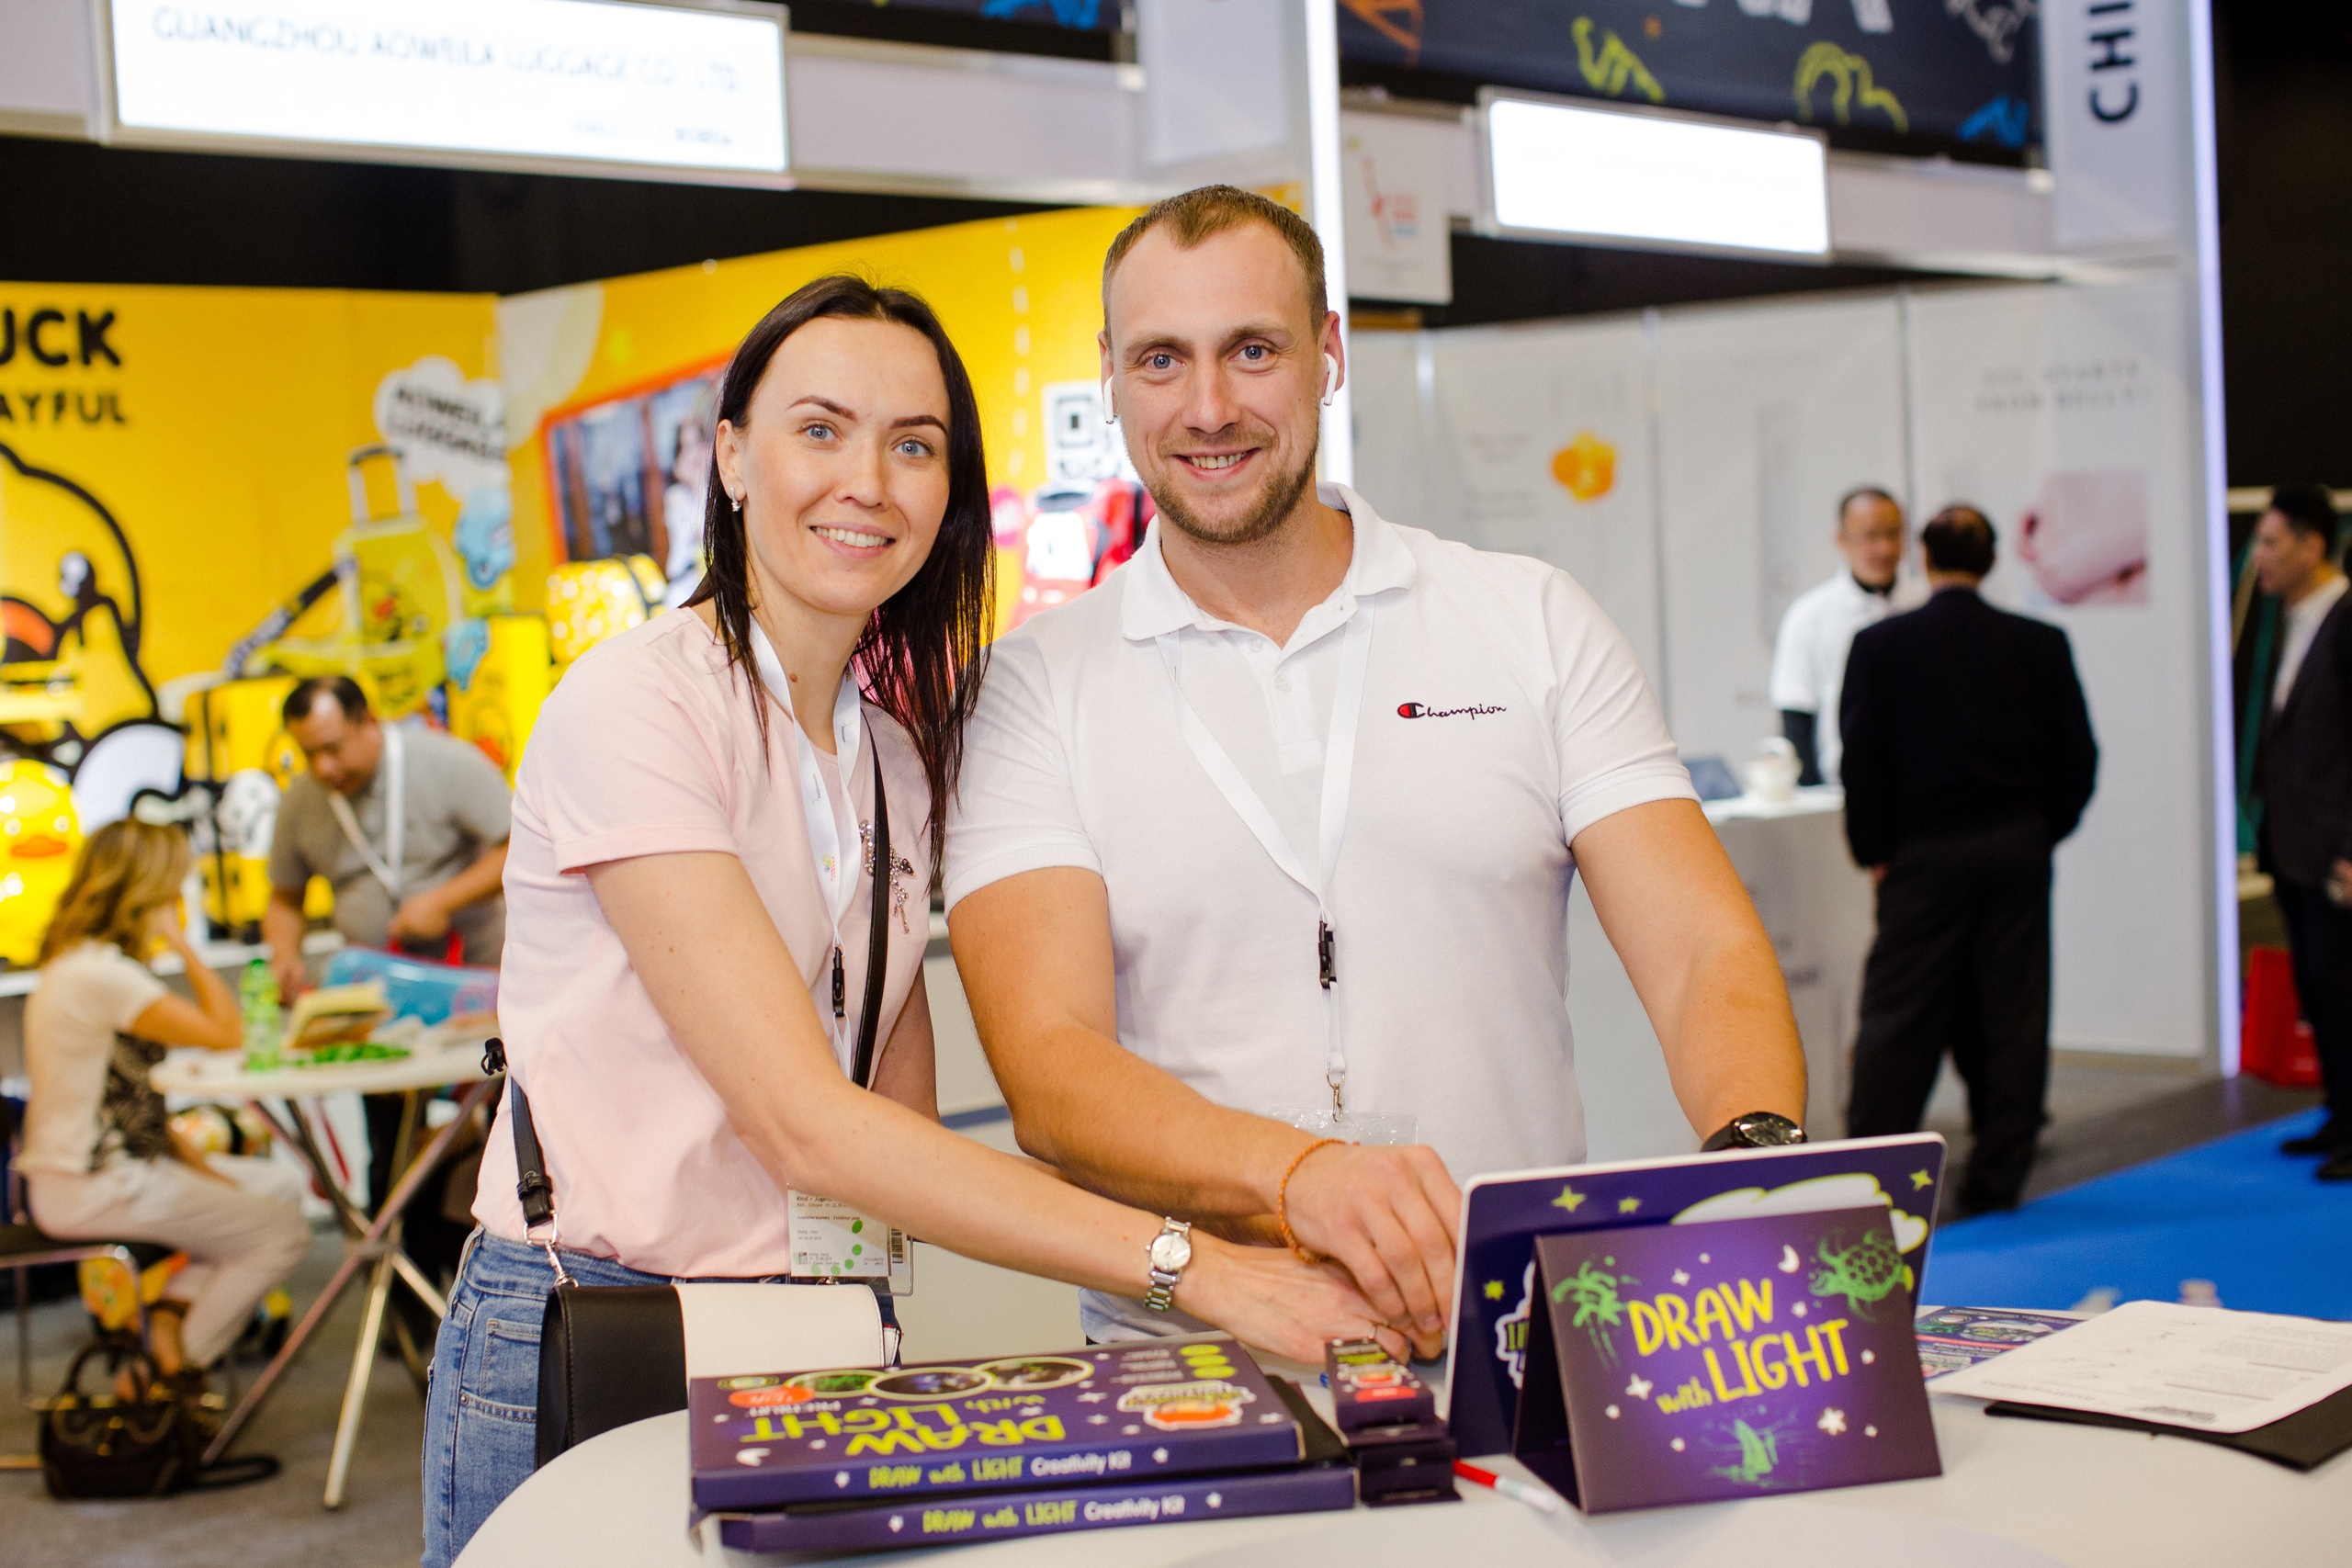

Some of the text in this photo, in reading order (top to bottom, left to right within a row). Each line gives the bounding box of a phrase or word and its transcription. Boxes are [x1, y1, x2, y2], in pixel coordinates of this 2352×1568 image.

[152, 5, 360, 57] GUANGZHOU
[371, 29, 496, 67] AOWEILA
[2088, 2, 2138, 122] CHI
[1396, 702, 1507, 720] Champion
[1627, 1278, 1774, 1357] DRAW
[1657, 1319, 1850, 1416] with LIGHT
[740, 1402, 962, 1444] LIGHT
[844, 1415, 1066, 1456] DRAW
[868, 1450, 1132, 1489] DRAW with LIGHT Creativity Kit
[922, 1495, 1185, 1533] DRAW with LIGHT Creativity Kit
